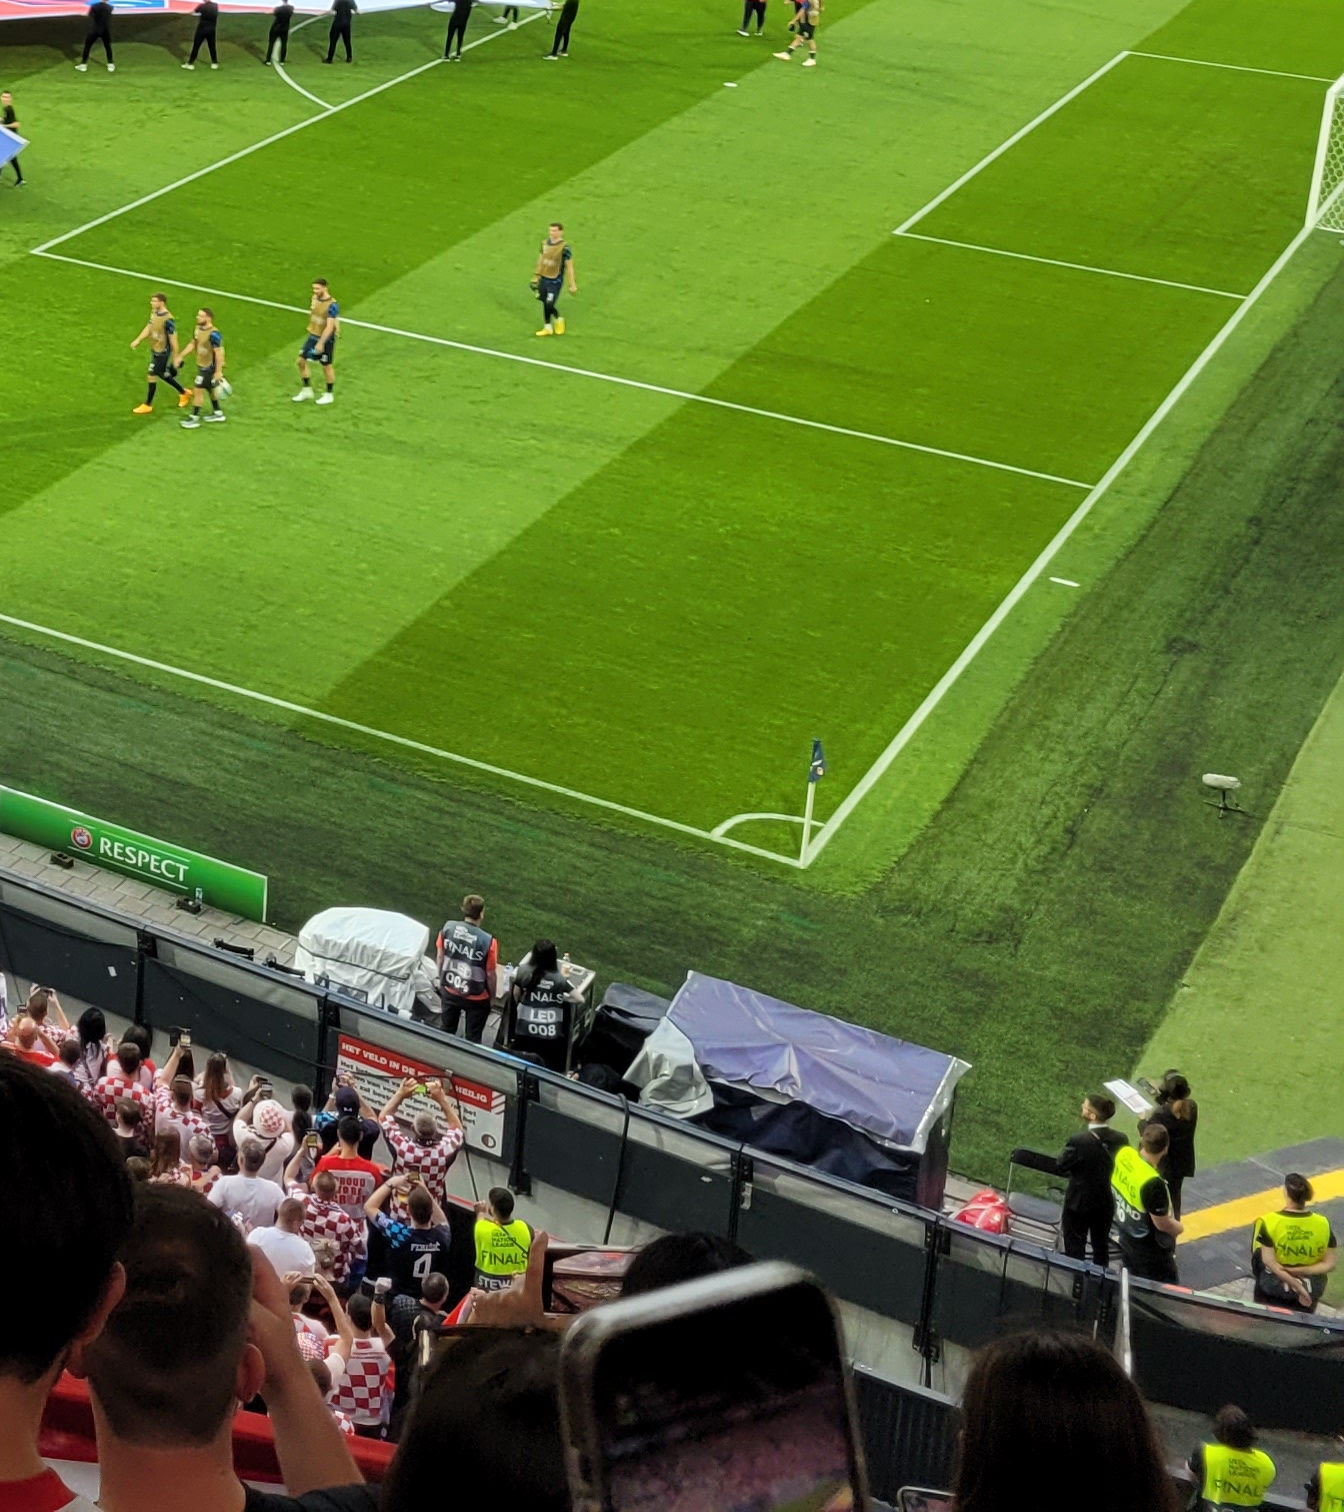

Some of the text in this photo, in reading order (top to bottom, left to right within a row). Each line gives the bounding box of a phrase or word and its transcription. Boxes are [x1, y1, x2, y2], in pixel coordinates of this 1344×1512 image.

[99, 836, 189, 883] RESPECT
[443, 938, 485, 962] FINALS
[448, 961, 473, 980] LED
[445, 972, 470, 993] 004
[530, 990, 564, 1005] NALS
[529, 1008, 557, 1024] LED
[528, 1023, 557, 1037] 008
[341, 1041, 416, 1077] HET VELD IN DE
[455, 1084, 489, 1104] HEILIG
[480, 1249, 528, 1267] FINALS
[1274, 1241, 1325, 1258] FINALS
[413, 1252, 432, 1278] 4
[478, 1274, 512, 1290] STEW
